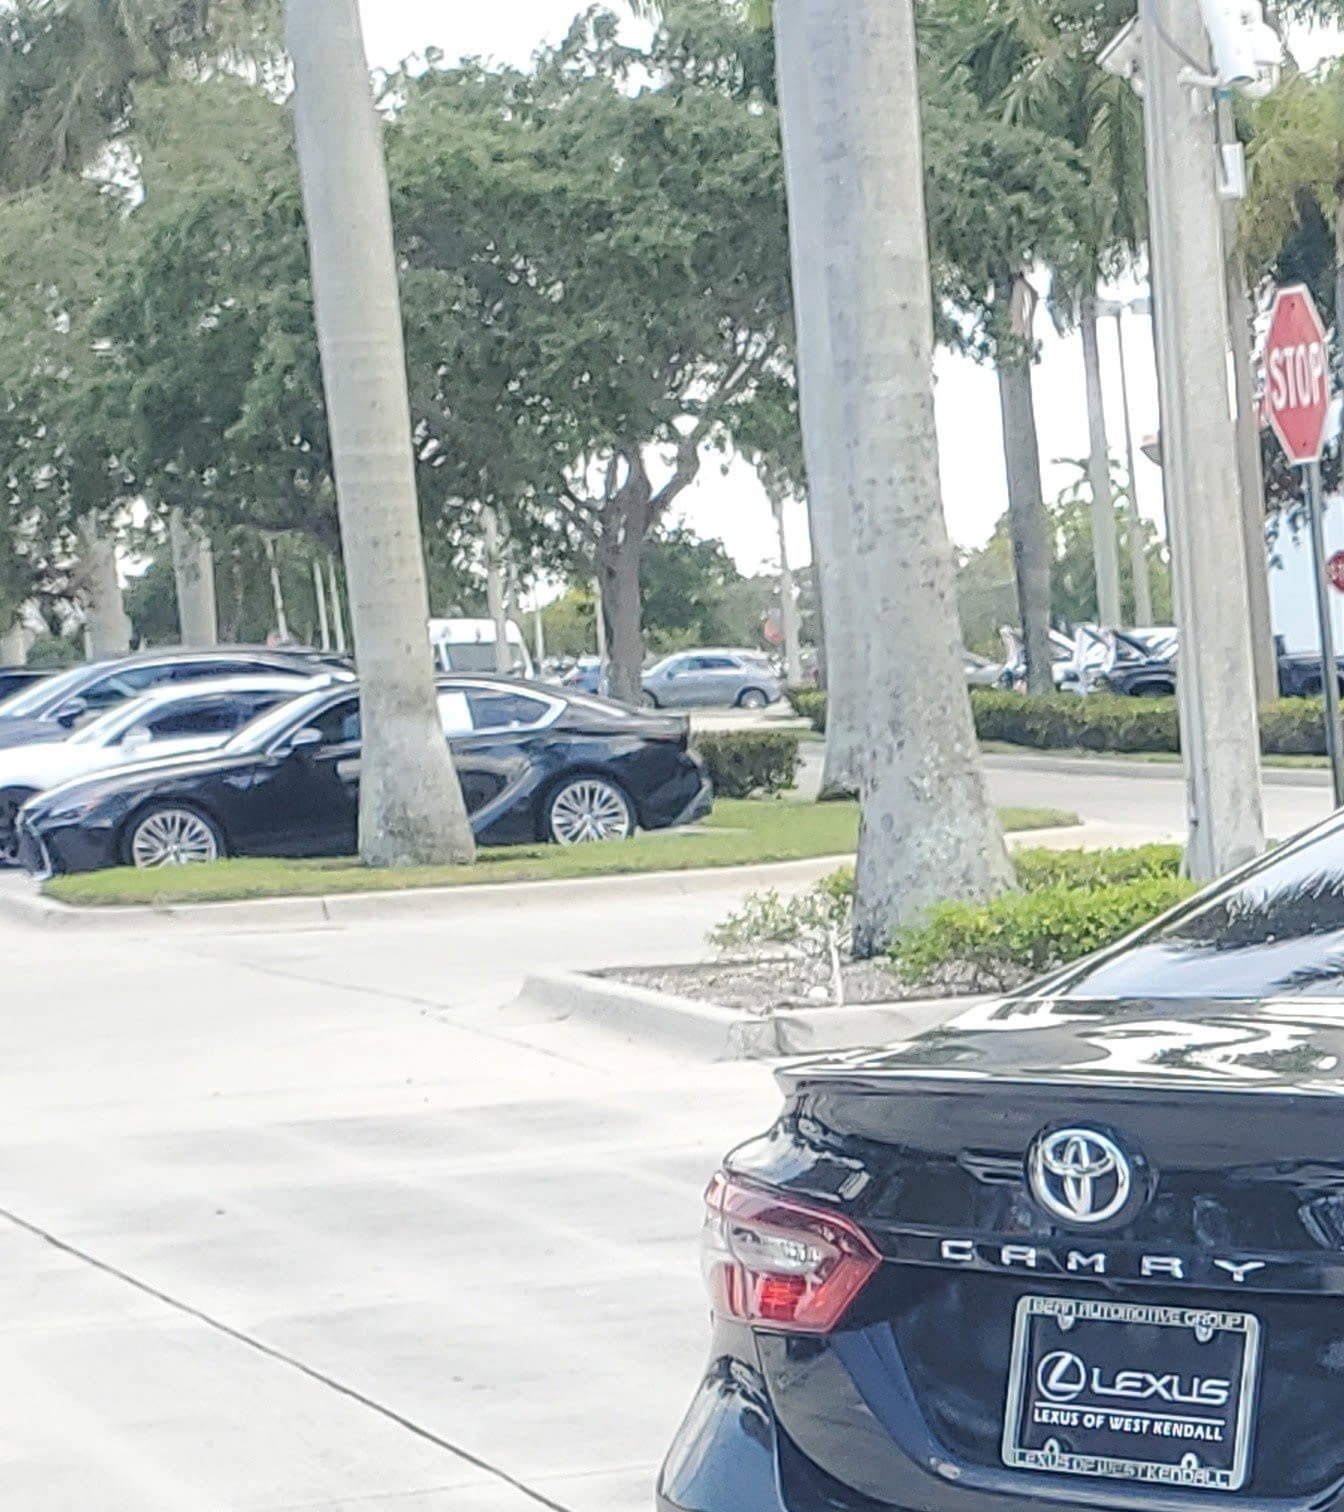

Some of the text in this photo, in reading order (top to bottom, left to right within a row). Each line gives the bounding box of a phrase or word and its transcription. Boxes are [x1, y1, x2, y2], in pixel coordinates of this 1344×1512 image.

[1269, 341, 1322, 411] STOP
[941, 1240, 1266, 1282] CAMRY
[1079, 1302, 1181, 1326] AUTOMOTIVE
[1184, 1310, 1244, 1331] GROUP
[1091, 1367, 1230, 1406] LEXUS
[1033, 1408, 1224, 1441] LEXUS OF WEST KENDALL
[1015, 1450, 1069, 1469] LEXUS
[1072, 1456, 1098, 1473] OF
[1149, 1463, 1230, 1487] KENDALL
